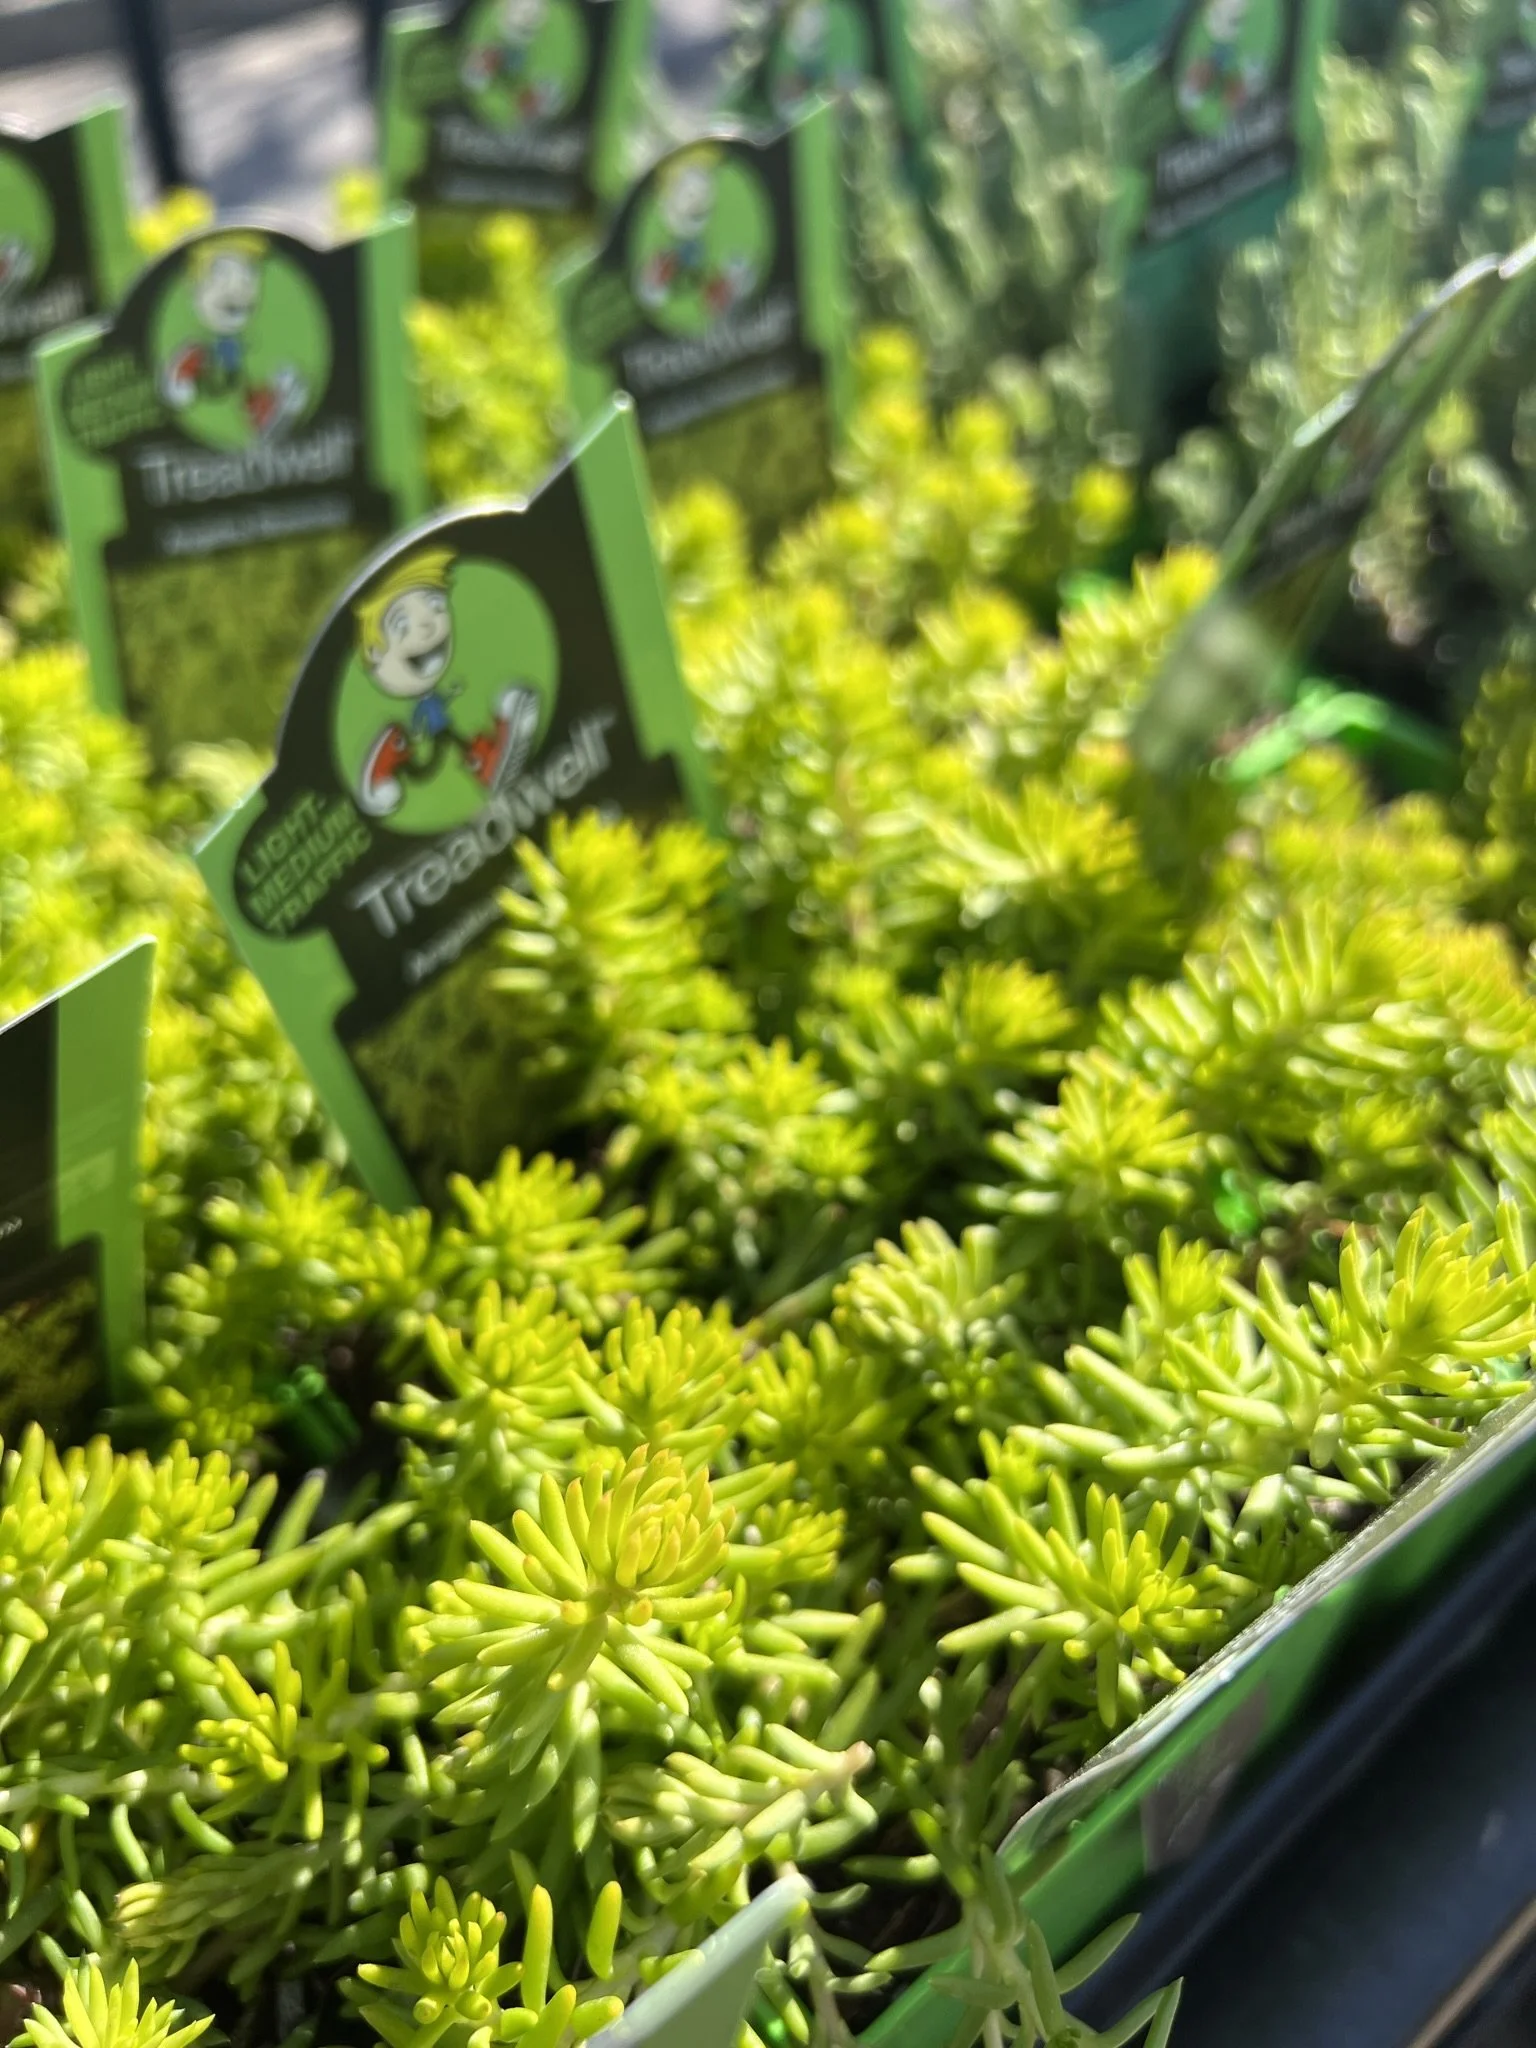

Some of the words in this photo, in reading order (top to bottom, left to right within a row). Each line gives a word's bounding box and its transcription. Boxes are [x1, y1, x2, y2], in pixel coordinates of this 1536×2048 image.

[250, 801, 356, 918] MEDIUM
[268, 827, 372, 937] TRAFFIC
[351, 716, 612, 938] Treadwell
